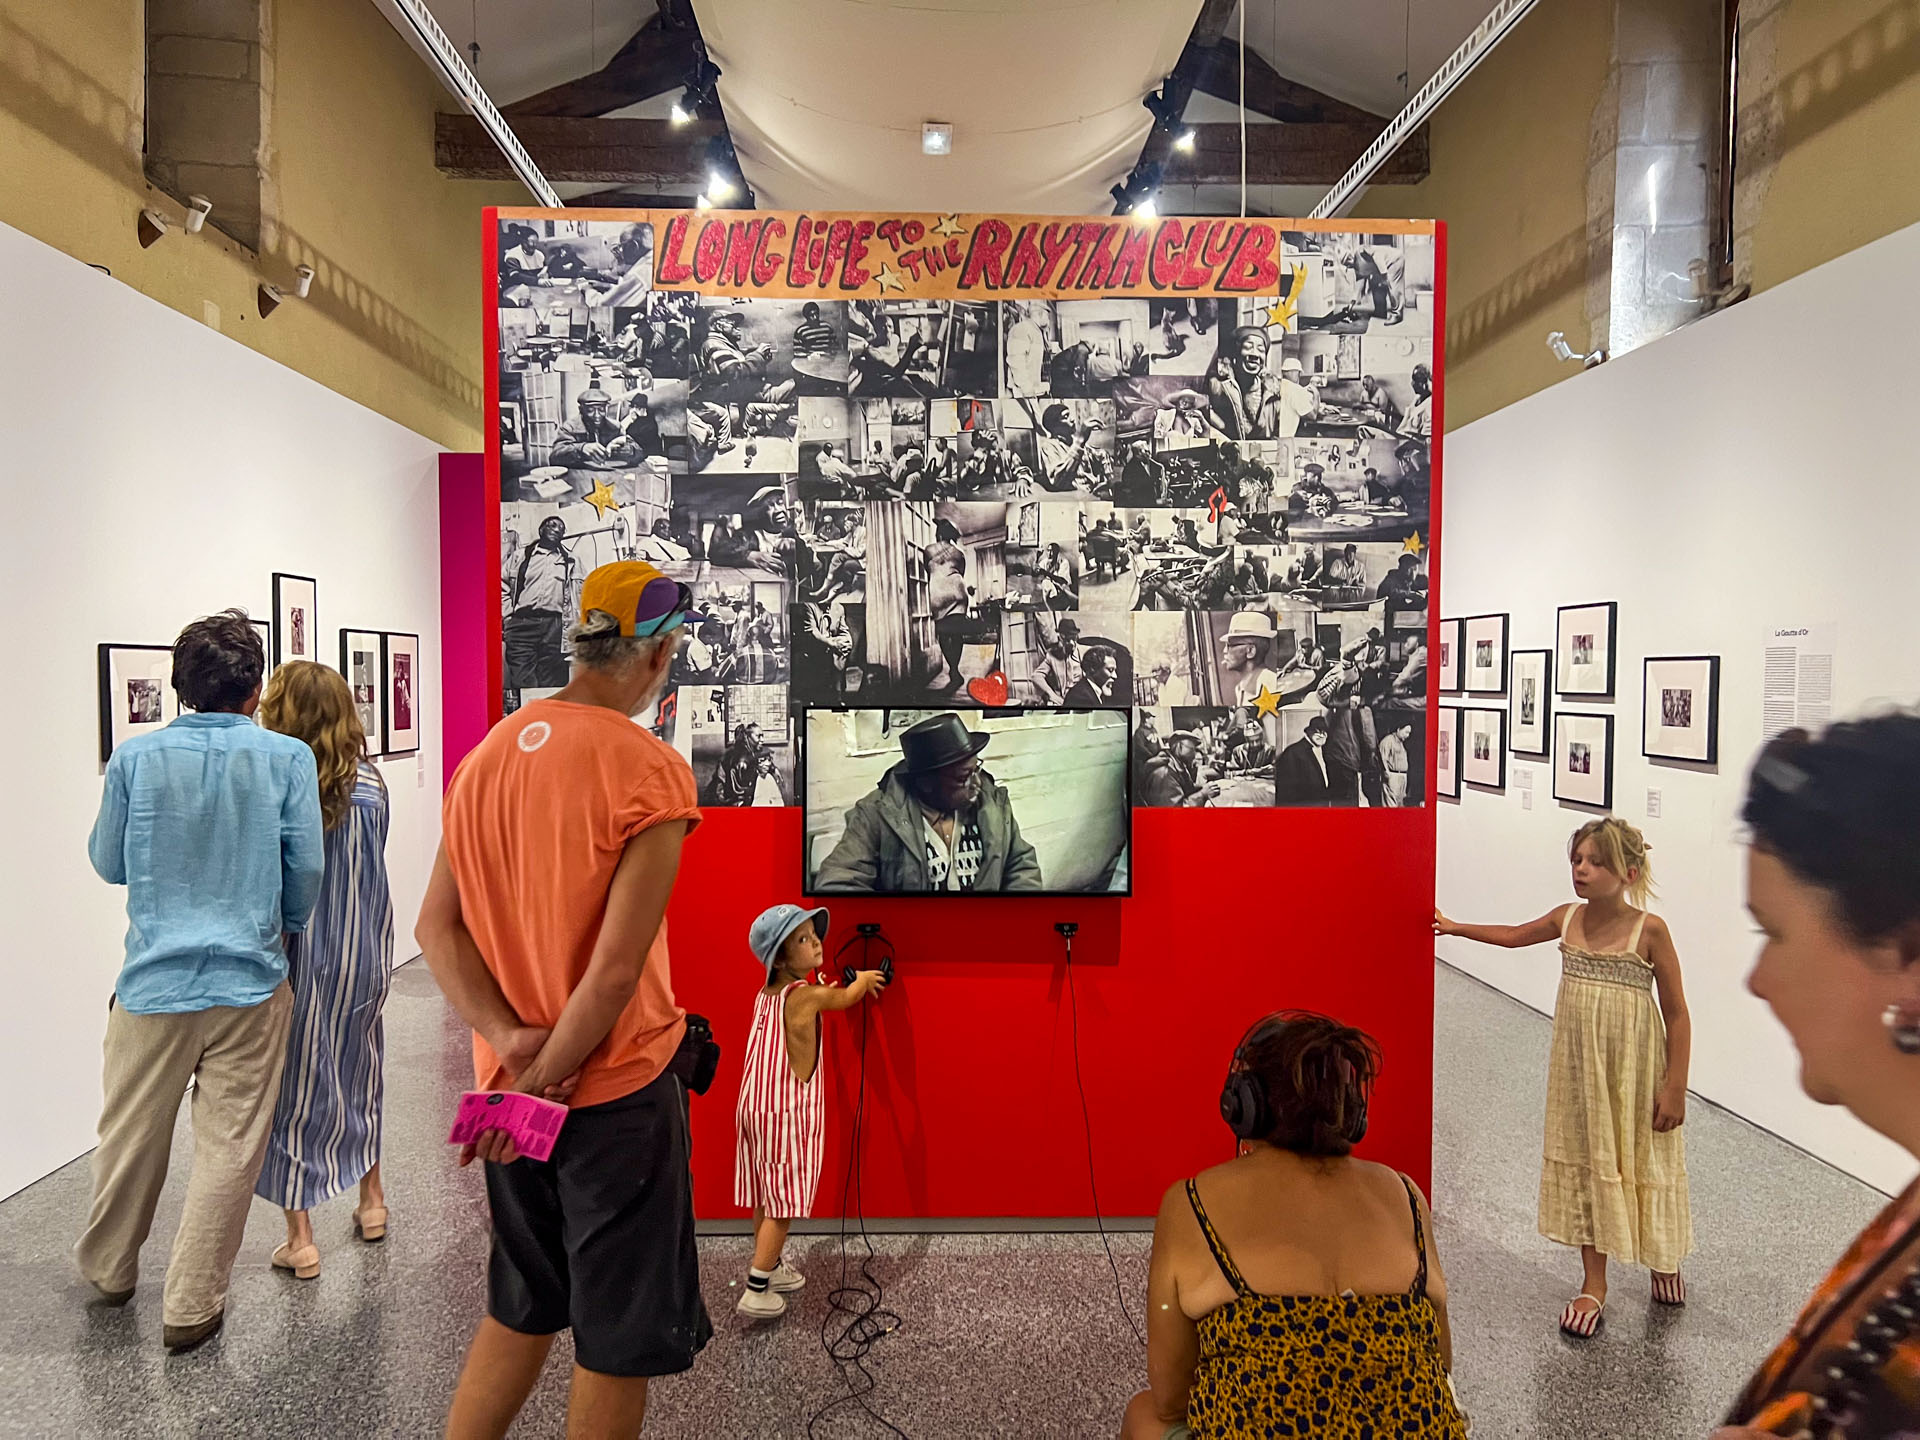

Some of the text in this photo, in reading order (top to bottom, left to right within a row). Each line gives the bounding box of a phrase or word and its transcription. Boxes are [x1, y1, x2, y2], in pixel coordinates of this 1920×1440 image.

[656, 214, 787, 288] LONG
[877, 219, 925, 252] TO
[898, 238, 964, 282] THE
[1149, 217, 1280, 292] CLUB
